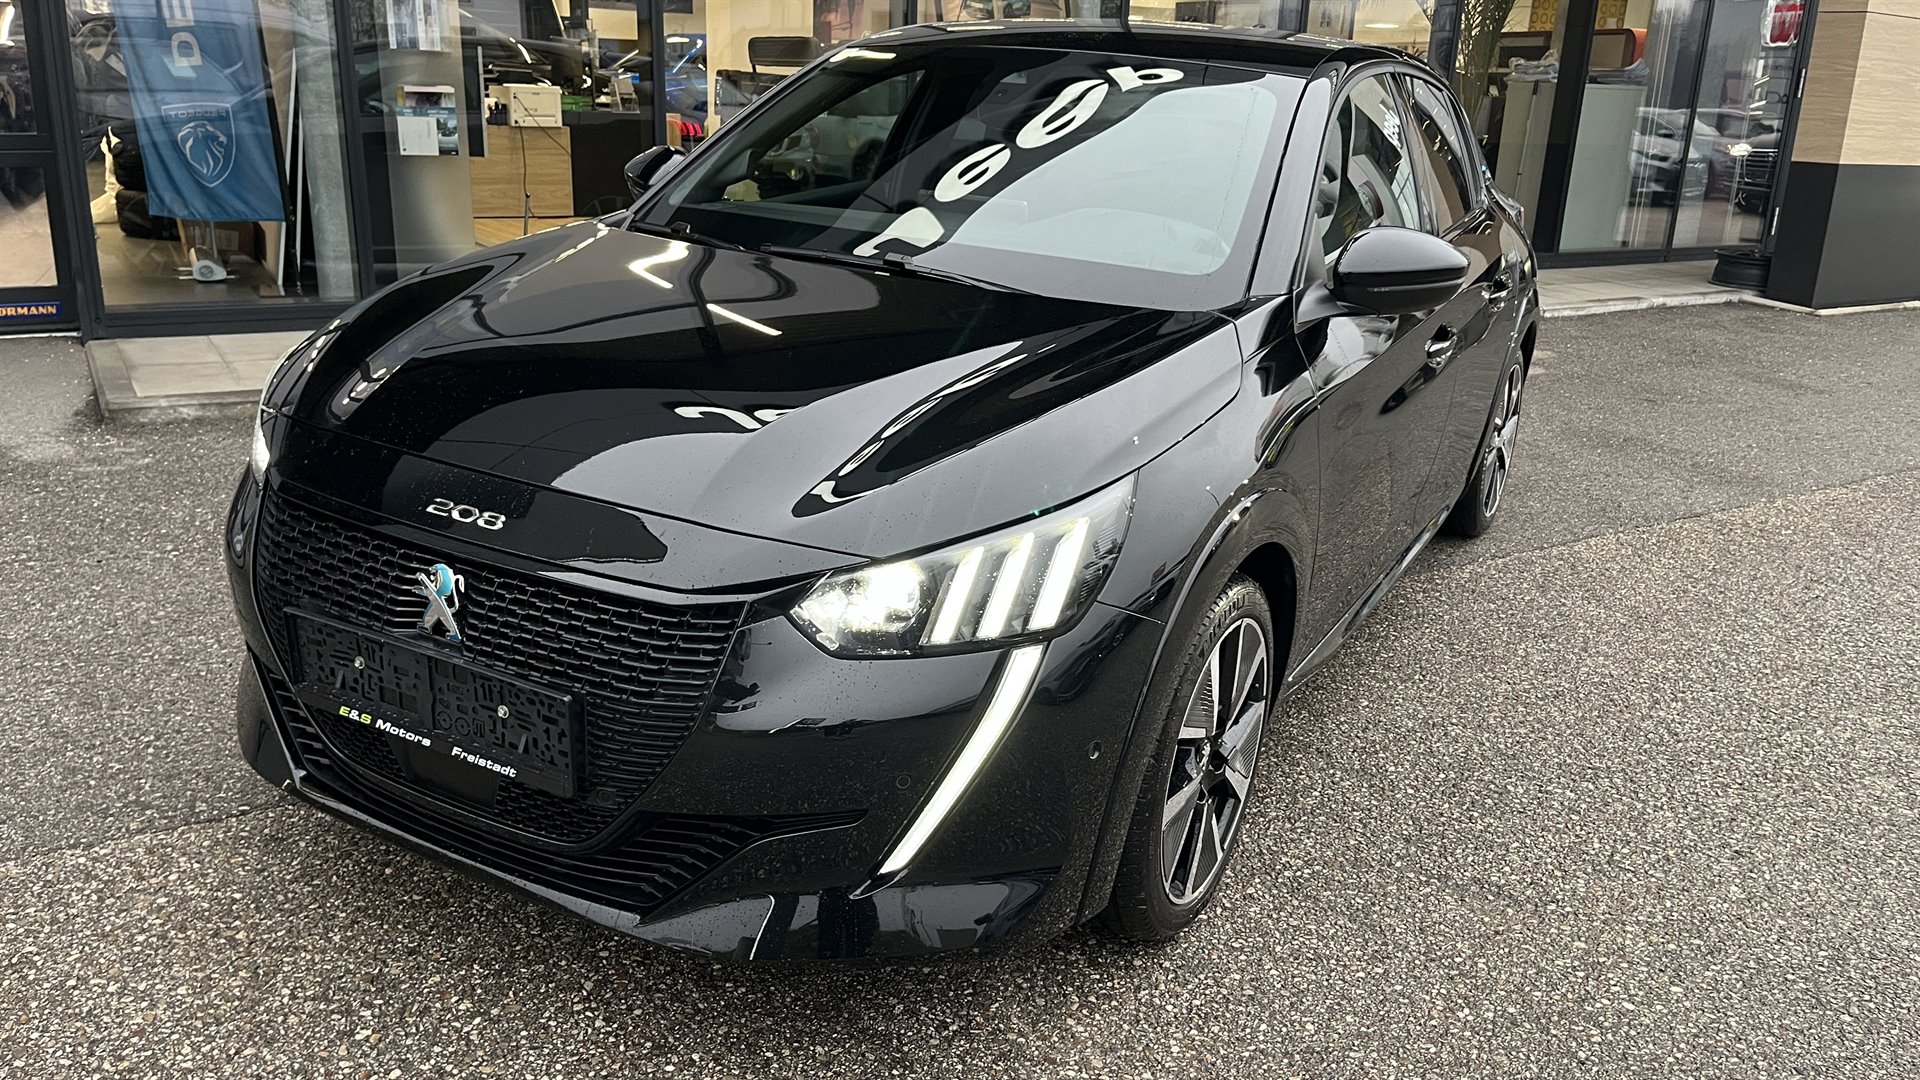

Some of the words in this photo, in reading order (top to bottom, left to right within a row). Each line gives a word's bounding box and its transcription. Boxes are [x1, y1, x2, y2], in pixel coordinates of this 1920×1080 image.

[425, 498, 506, 531] 208
[338, 705, 373, 725] E&S
[375, 718, 432, 748] Motors
[451, 746, 518, 779] Freistadt
